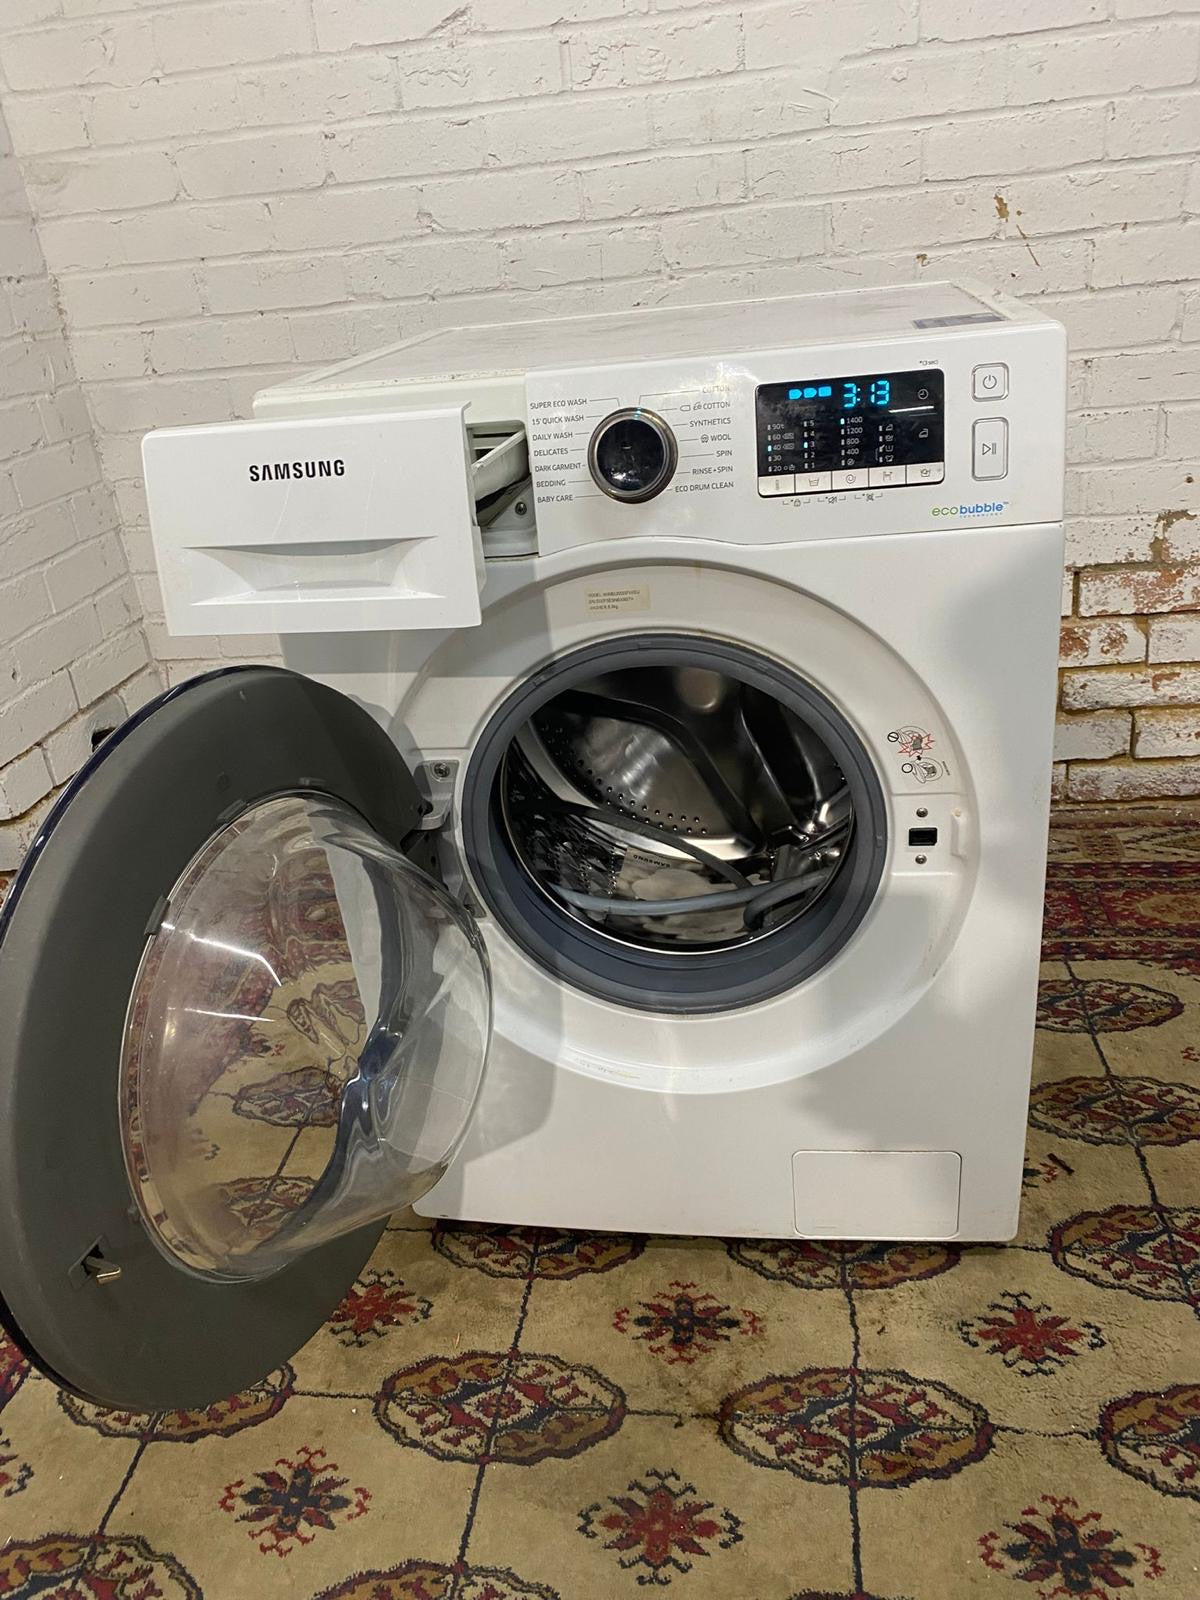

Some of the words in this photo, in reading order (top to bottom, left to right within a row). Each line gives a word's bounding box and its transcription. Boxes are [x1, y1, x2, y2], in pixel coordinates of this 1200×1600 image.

[843, 380, 890, 408] 3:13
[530, 401, 551, 409] SUPER
[567, 398, 587, 406] WASH
[703, 401, 730, 410] COTTON
[564, 414, 584, 422] WASH
[690, 417, 731, 427] SYNTHETICS
[711, 433, 732, 441] WOOL
[534, 448, 568, 456] DELICATES
[249, 459, 345, 482] SAMSUNG
[552, 462, 581, 471] GARMENT
[536, 479, 566, 488] BEDDING
[690, 483, 710, 491] DRUM
[711, 481, 734, 490] CLEAN
